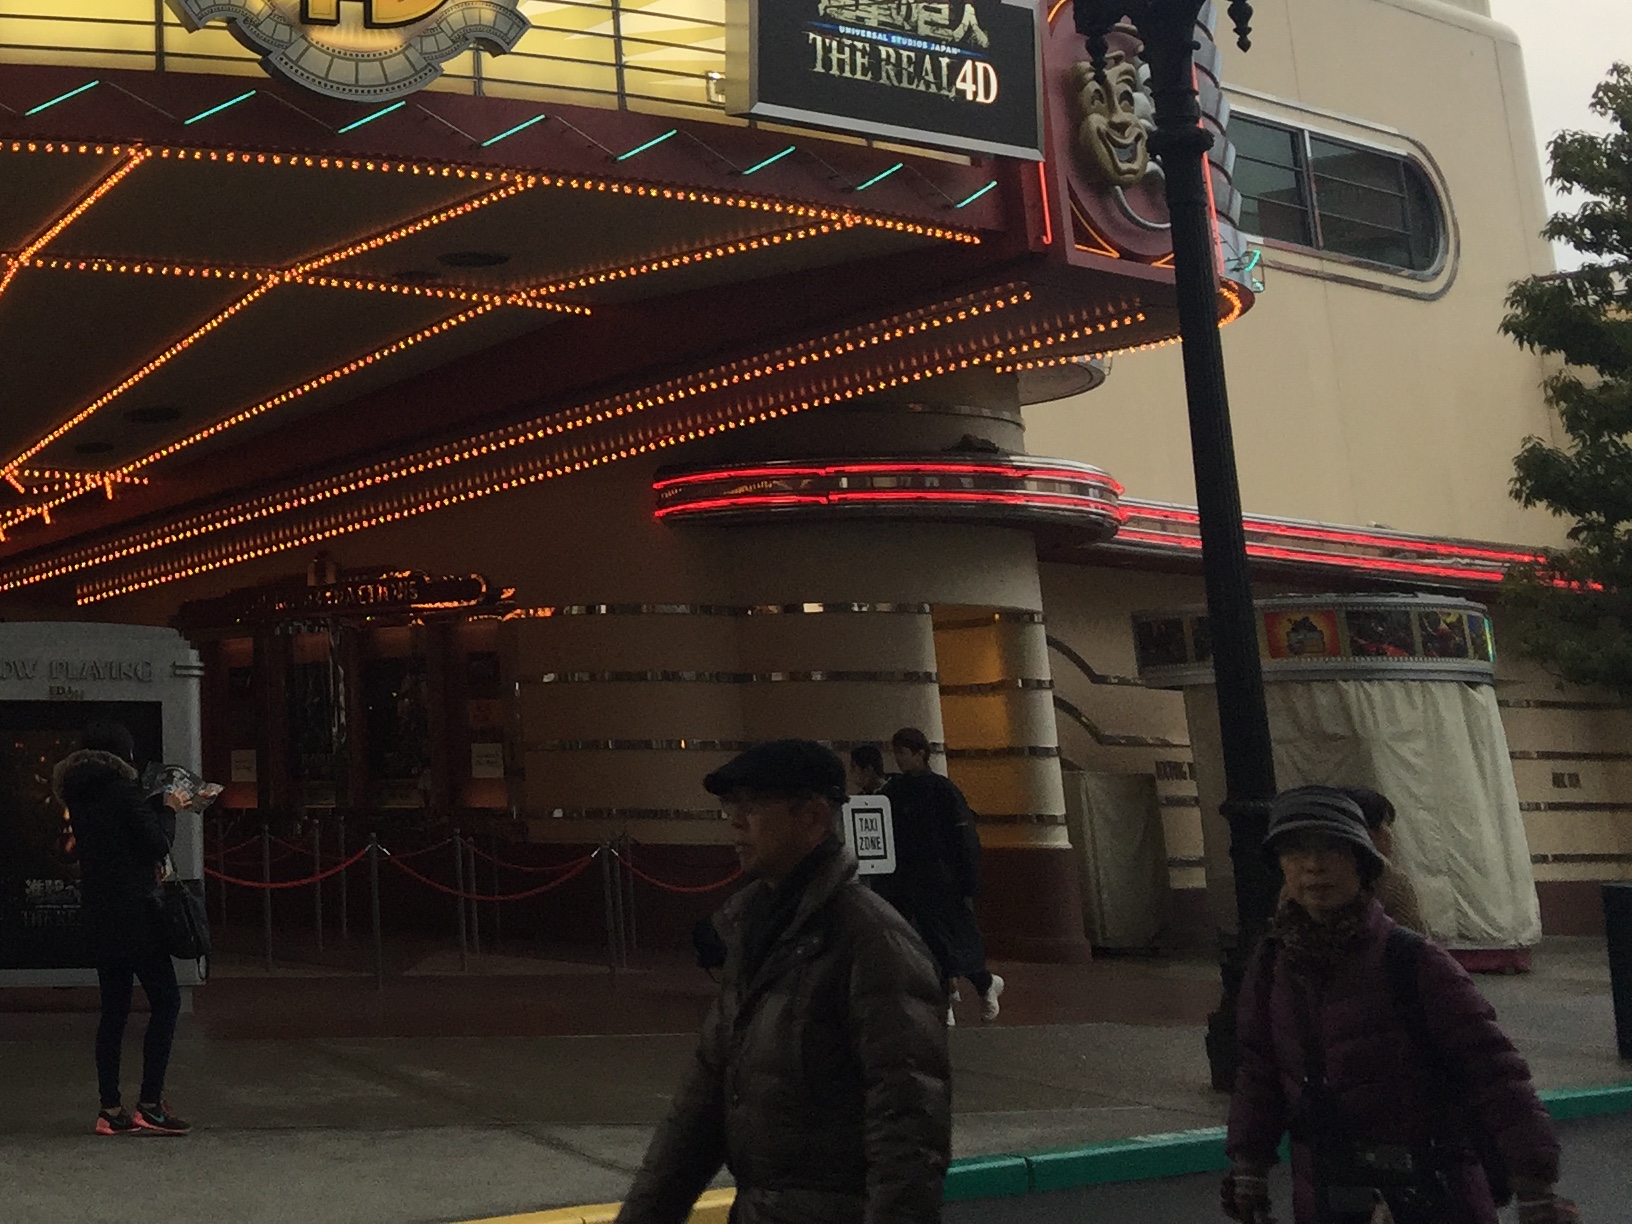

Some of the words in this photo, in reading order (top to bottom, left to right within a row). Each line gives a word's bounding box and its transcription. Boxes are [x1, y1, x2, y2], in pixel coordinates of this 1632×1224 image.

[838, 25, 889, 43] UNIVERSAL
[890, 34, 928, 50] STUDIOS
[808, 32, 873, 82] THE
[877, 45, 957, 101] REAL
[956, 59, 999, 105] 4D
[47, 660, 153, 683] PLAYING
[858, 816, 879, 832] TAXI
[859, 836, 882, 851] ZONE
